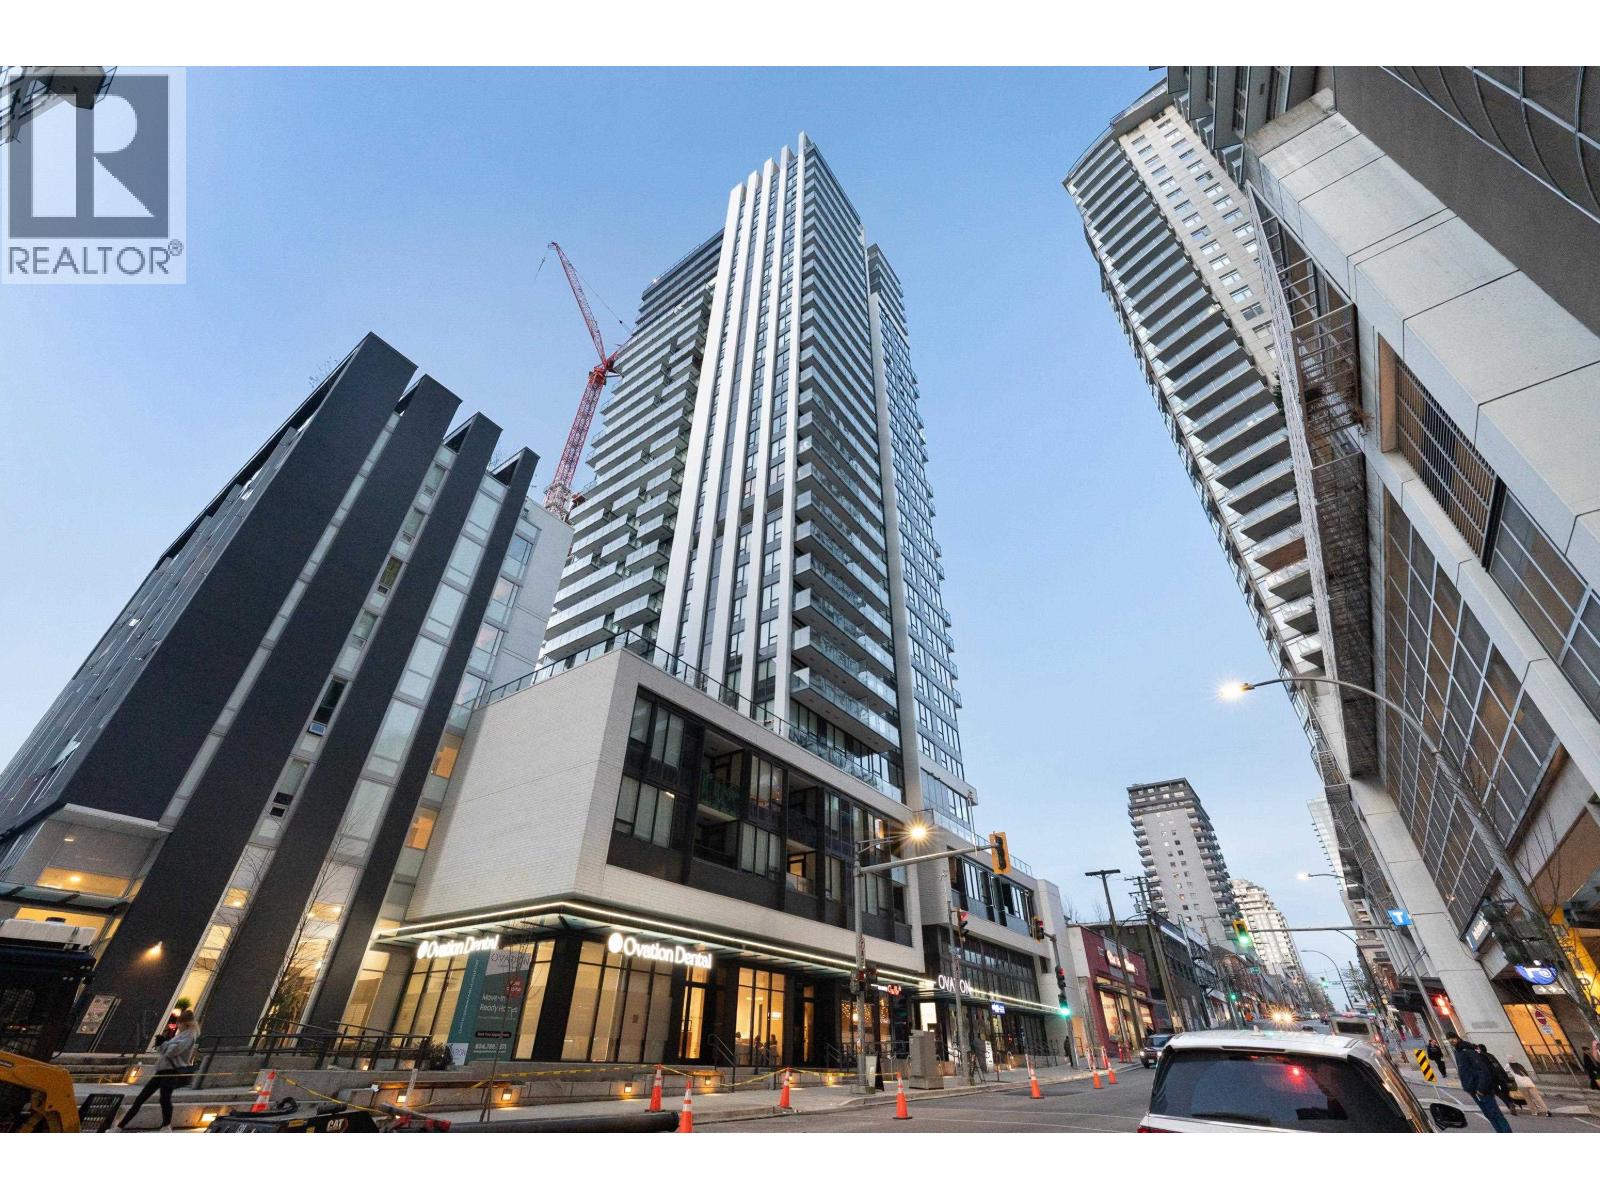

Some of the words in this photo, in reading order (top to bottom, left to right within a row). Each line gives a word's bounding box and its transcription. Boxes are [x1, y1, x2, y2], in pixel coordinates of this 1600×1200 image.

[427, 940, 464, 958] Ovation
[464, 934, 500, 954] Dental
[623, 937, 674, 962] Ovation
[674, 945, 712, 969] Dental
[938, 974, 972, 995] OVAON
[480, 1003, 498, 1013] Ready
[326, 1118, 345, 1132] CAT
